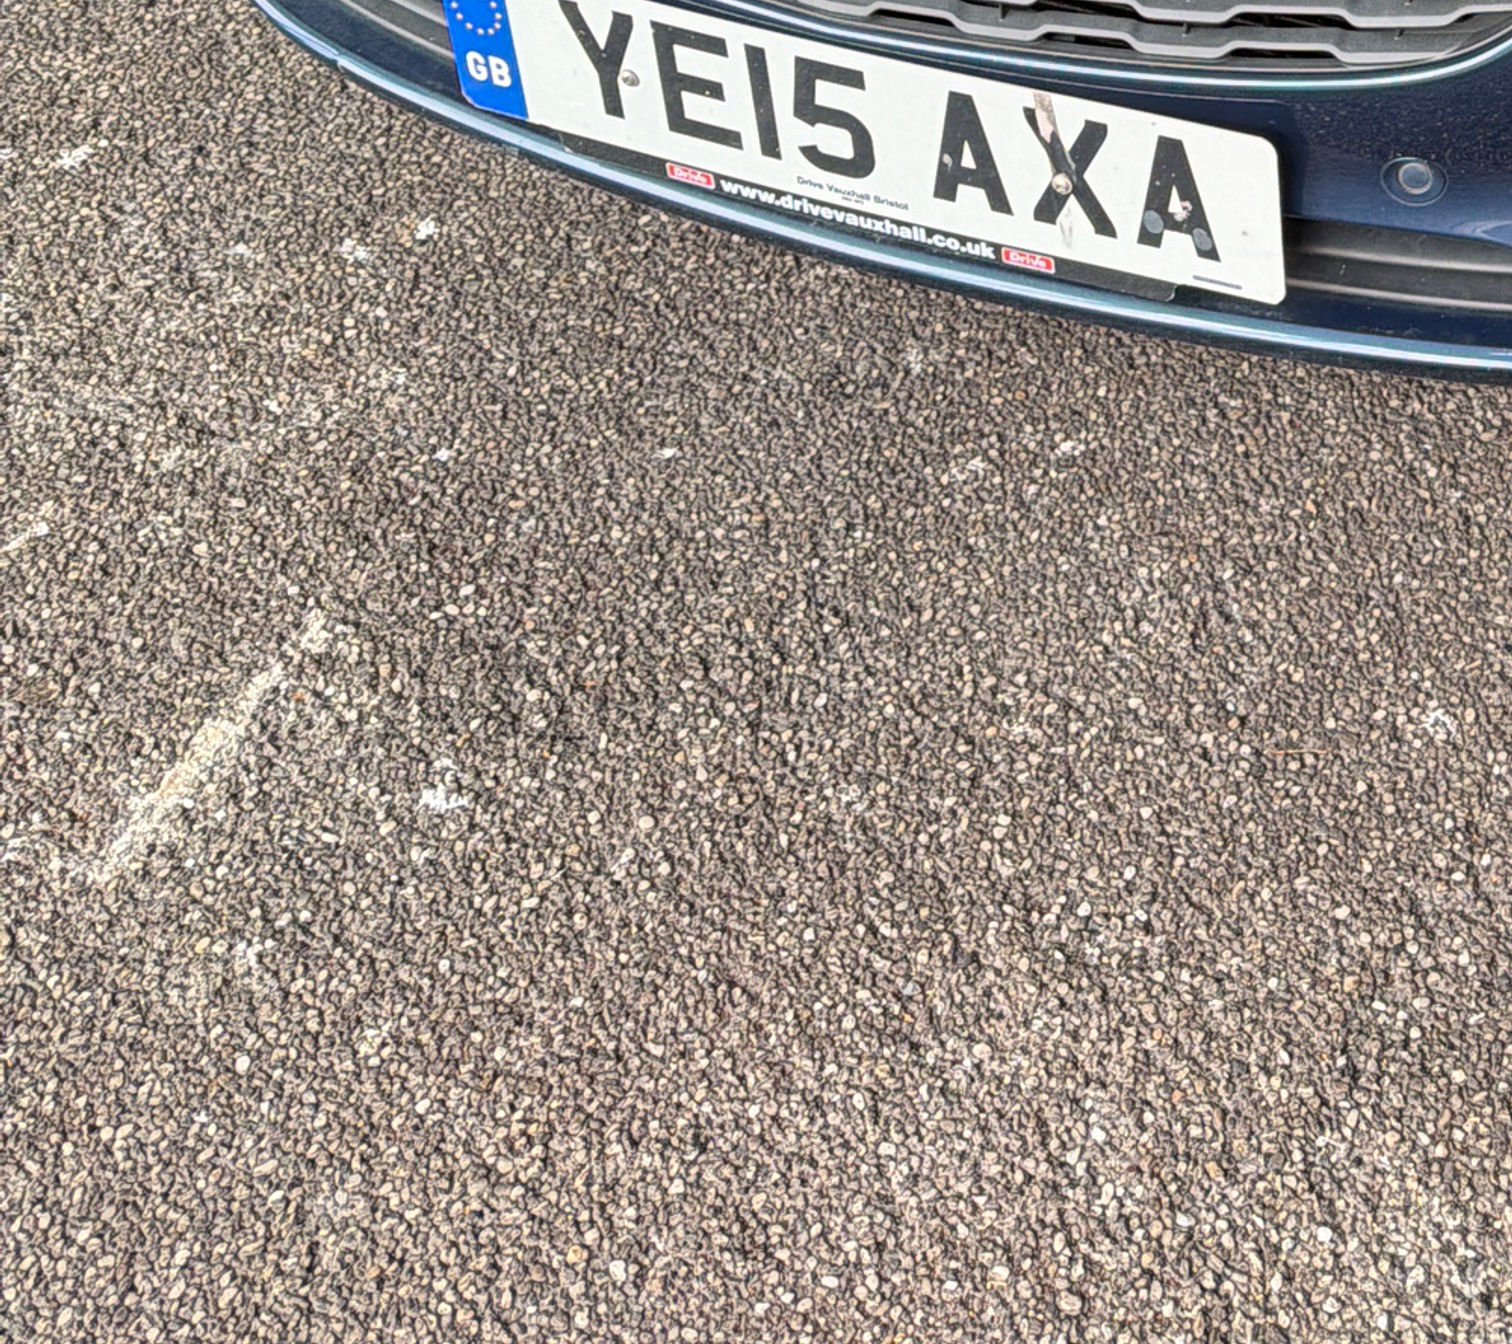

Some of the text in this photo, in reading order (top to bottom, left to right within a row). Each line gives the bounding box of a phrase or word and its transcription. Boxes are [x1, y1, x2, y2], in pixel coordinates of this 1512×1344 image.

[466, 50, 512, 88] GB
[797, 175, 824, 190] Drive
[826, 183, 871, 201] Vauxhall
[873, 194, 909, 211] Bristol
[933, 90, 1222, 263] AXA
[673, 167, 709, 185] Drive
[719, 178, 997, 260] www.drivevauxhall.co.uk
[1008, 249, 1047, 268] Drive
